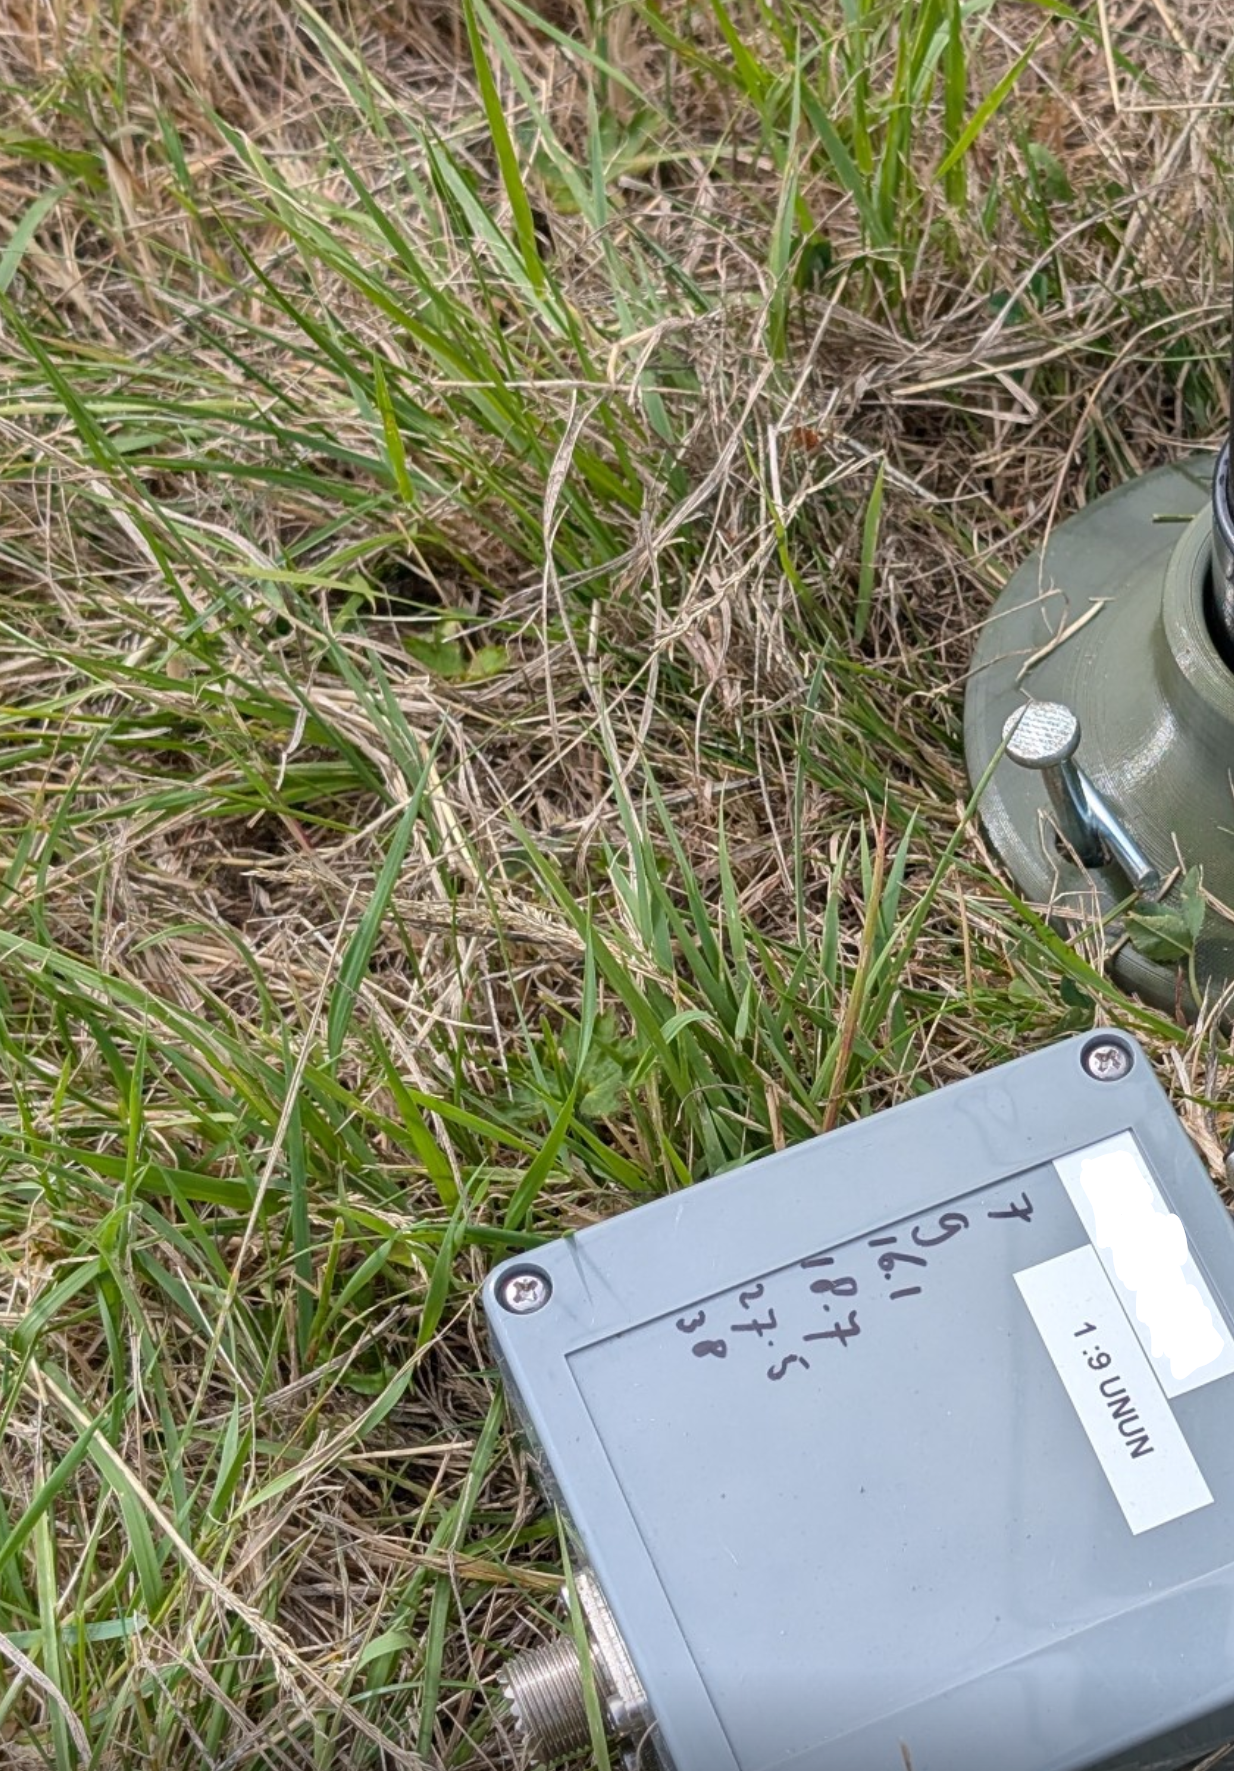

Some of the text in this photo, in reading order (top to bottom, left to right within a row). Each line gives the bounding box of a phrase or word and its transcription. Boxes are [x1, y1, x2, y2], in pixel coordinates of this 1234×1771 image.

[911, 1212, 970, 1247] 9
[987, 1192, 1034, 1223] 7
[868, 1236, 928, 1300] 16.1
[676, 1309, 728, 1359] 38
[730, 1283, 811, 1381] 27.5
[800, 1257, 861, 1347] 18.7
[1098, 1375, 1155, 1460] UNUN
